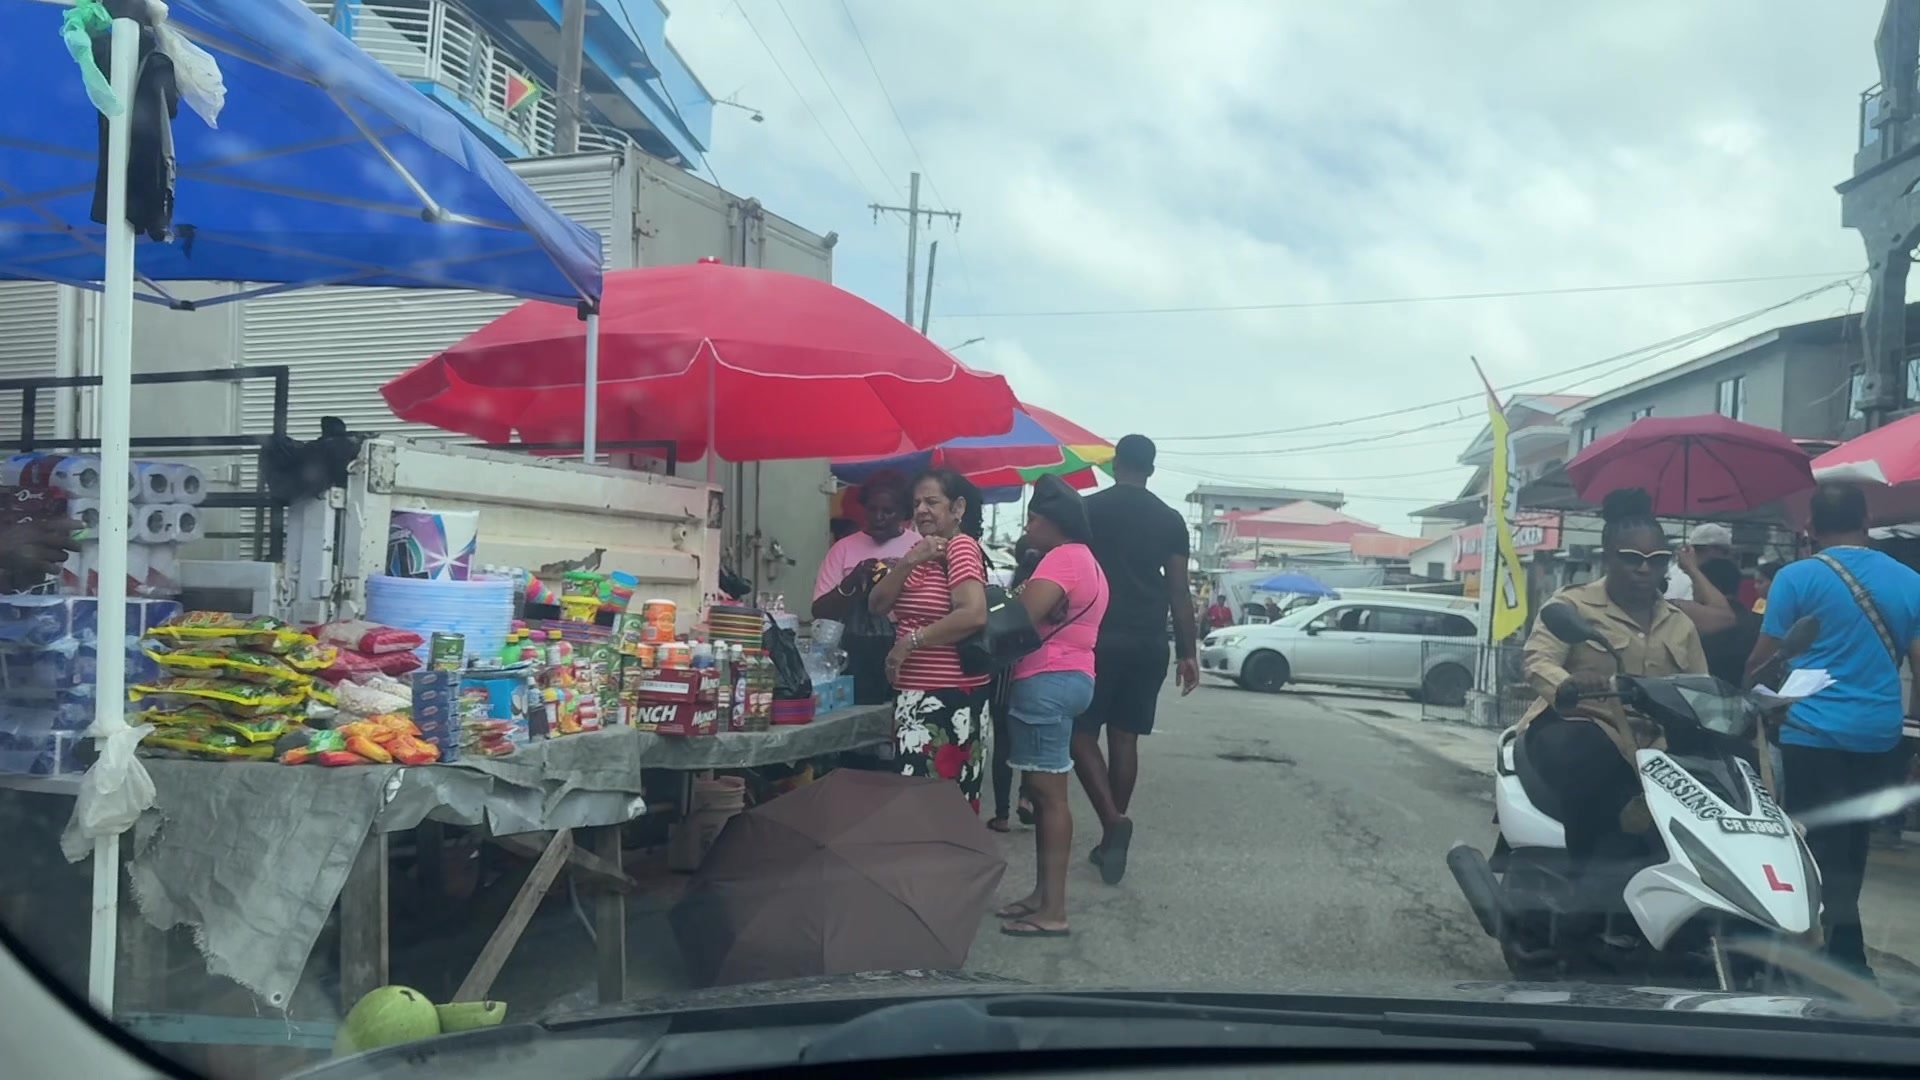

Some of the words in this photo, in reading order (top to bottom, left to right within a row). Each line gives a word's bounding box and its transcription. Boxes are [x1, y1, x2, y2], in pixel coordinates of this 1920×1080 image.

[637, 705, 678, 723] NCH
[1640, 756, 1726, 821] BLESSING
[1721, 818, 1745, 831] CR
[1762, 864, 1795, 892] L
